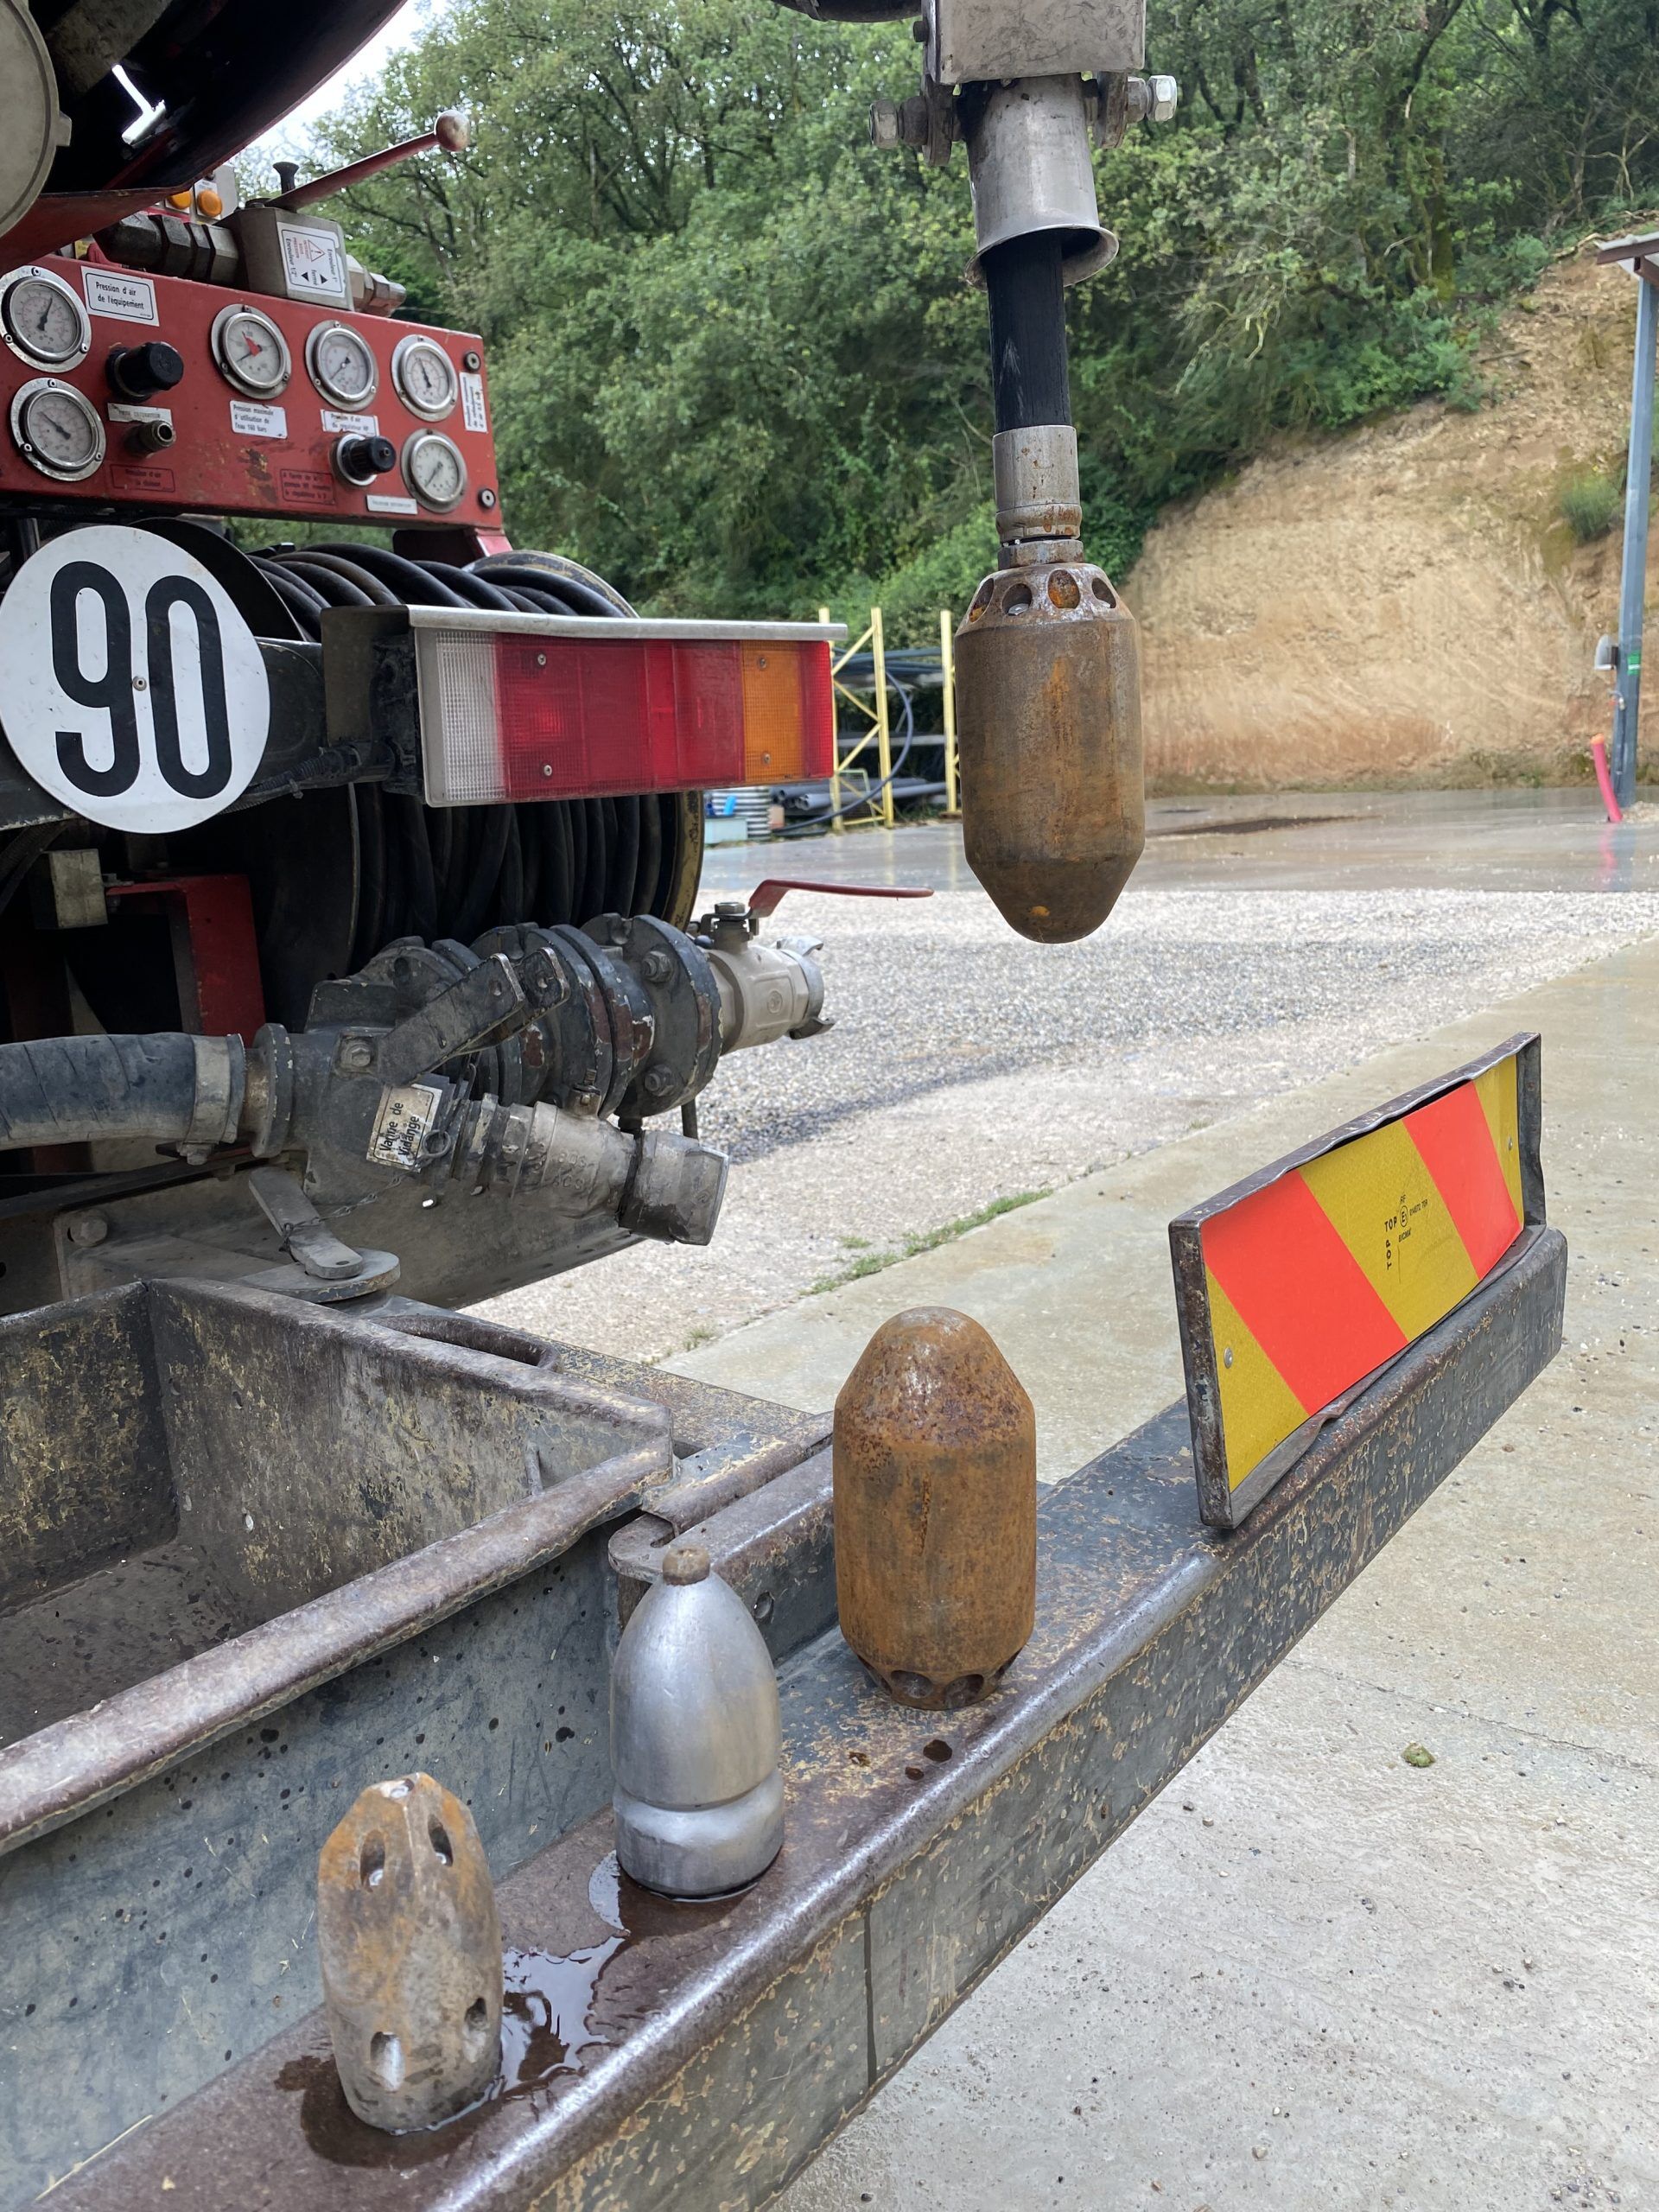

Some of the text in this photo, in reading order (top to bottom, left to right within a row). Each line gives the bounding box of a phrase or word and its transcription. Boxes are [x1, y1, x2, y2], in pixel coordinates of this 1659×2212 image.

[95, 281, 120, 293] Pression
[98, 294, 144, 310] de l'équipement
[50, 561, 232, 799] 90
[379, 1103, 404, 1151] Vanne de
[398, 1116, 421, 1156] Vidange
[1384, 1216, 1397, 1232] TOP
